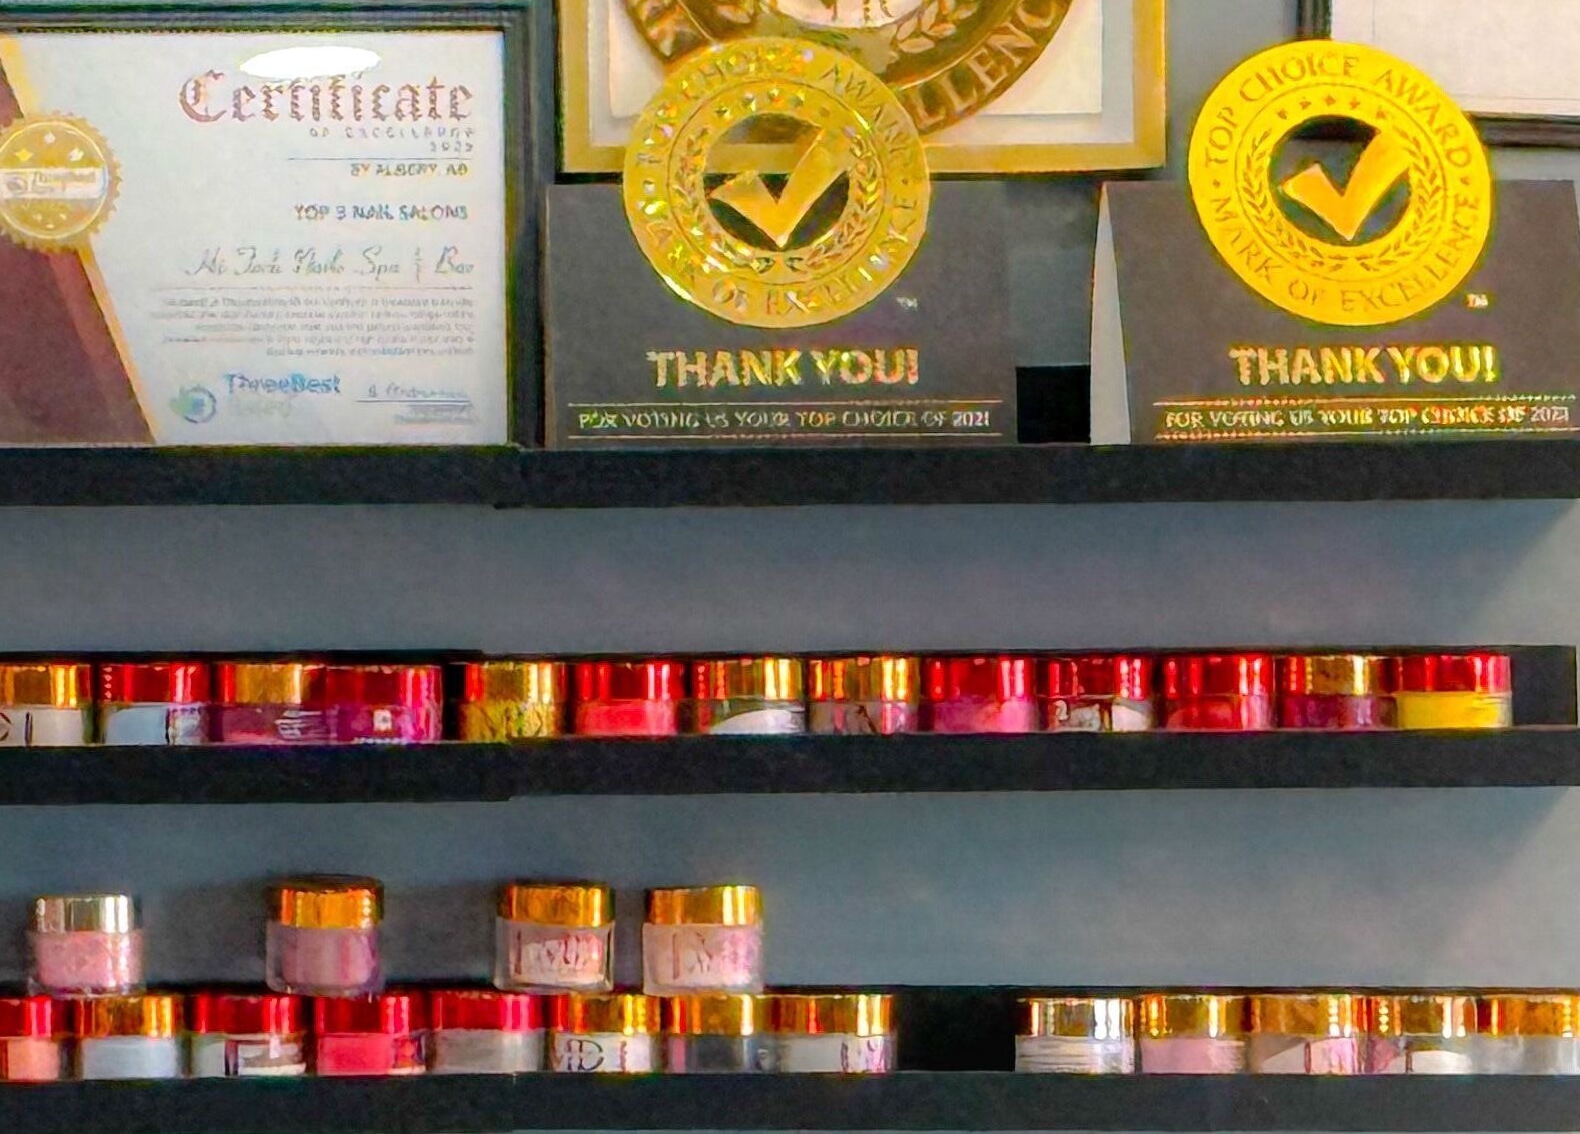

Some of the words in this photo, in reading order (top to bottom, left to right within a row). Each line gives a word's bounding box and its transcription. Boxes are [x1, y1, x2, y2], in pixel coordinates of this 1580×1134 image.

[178, 70, 475, 123] Certificate
[1204, 105, 1239, 169] TOP
[1238, 51, 1361, 104] CHOICE
[1373, 67, 1472, 170] AWARD
[294, 204, 330, 221] TOP
[336, 205, 348, 221] 3
[398, 204, 469, 221] SALONS
[1211, 195, 1282, 286] MARK
[1339, 192, 1480, 314] EXCELLENCE
[645, 350, 803, 388] THANK
[808, 347, 919, 387] YOU!
[1227, 346, 1388, 386] THANK
[1388, 344, 1498, 385] YOU!
[795, 410, 837, 428] TOP
[951, 410, 990, 428] 2021
[1165, 409, 1205, 428] FOR
[1208, 409, 1285, 428] VOTING
